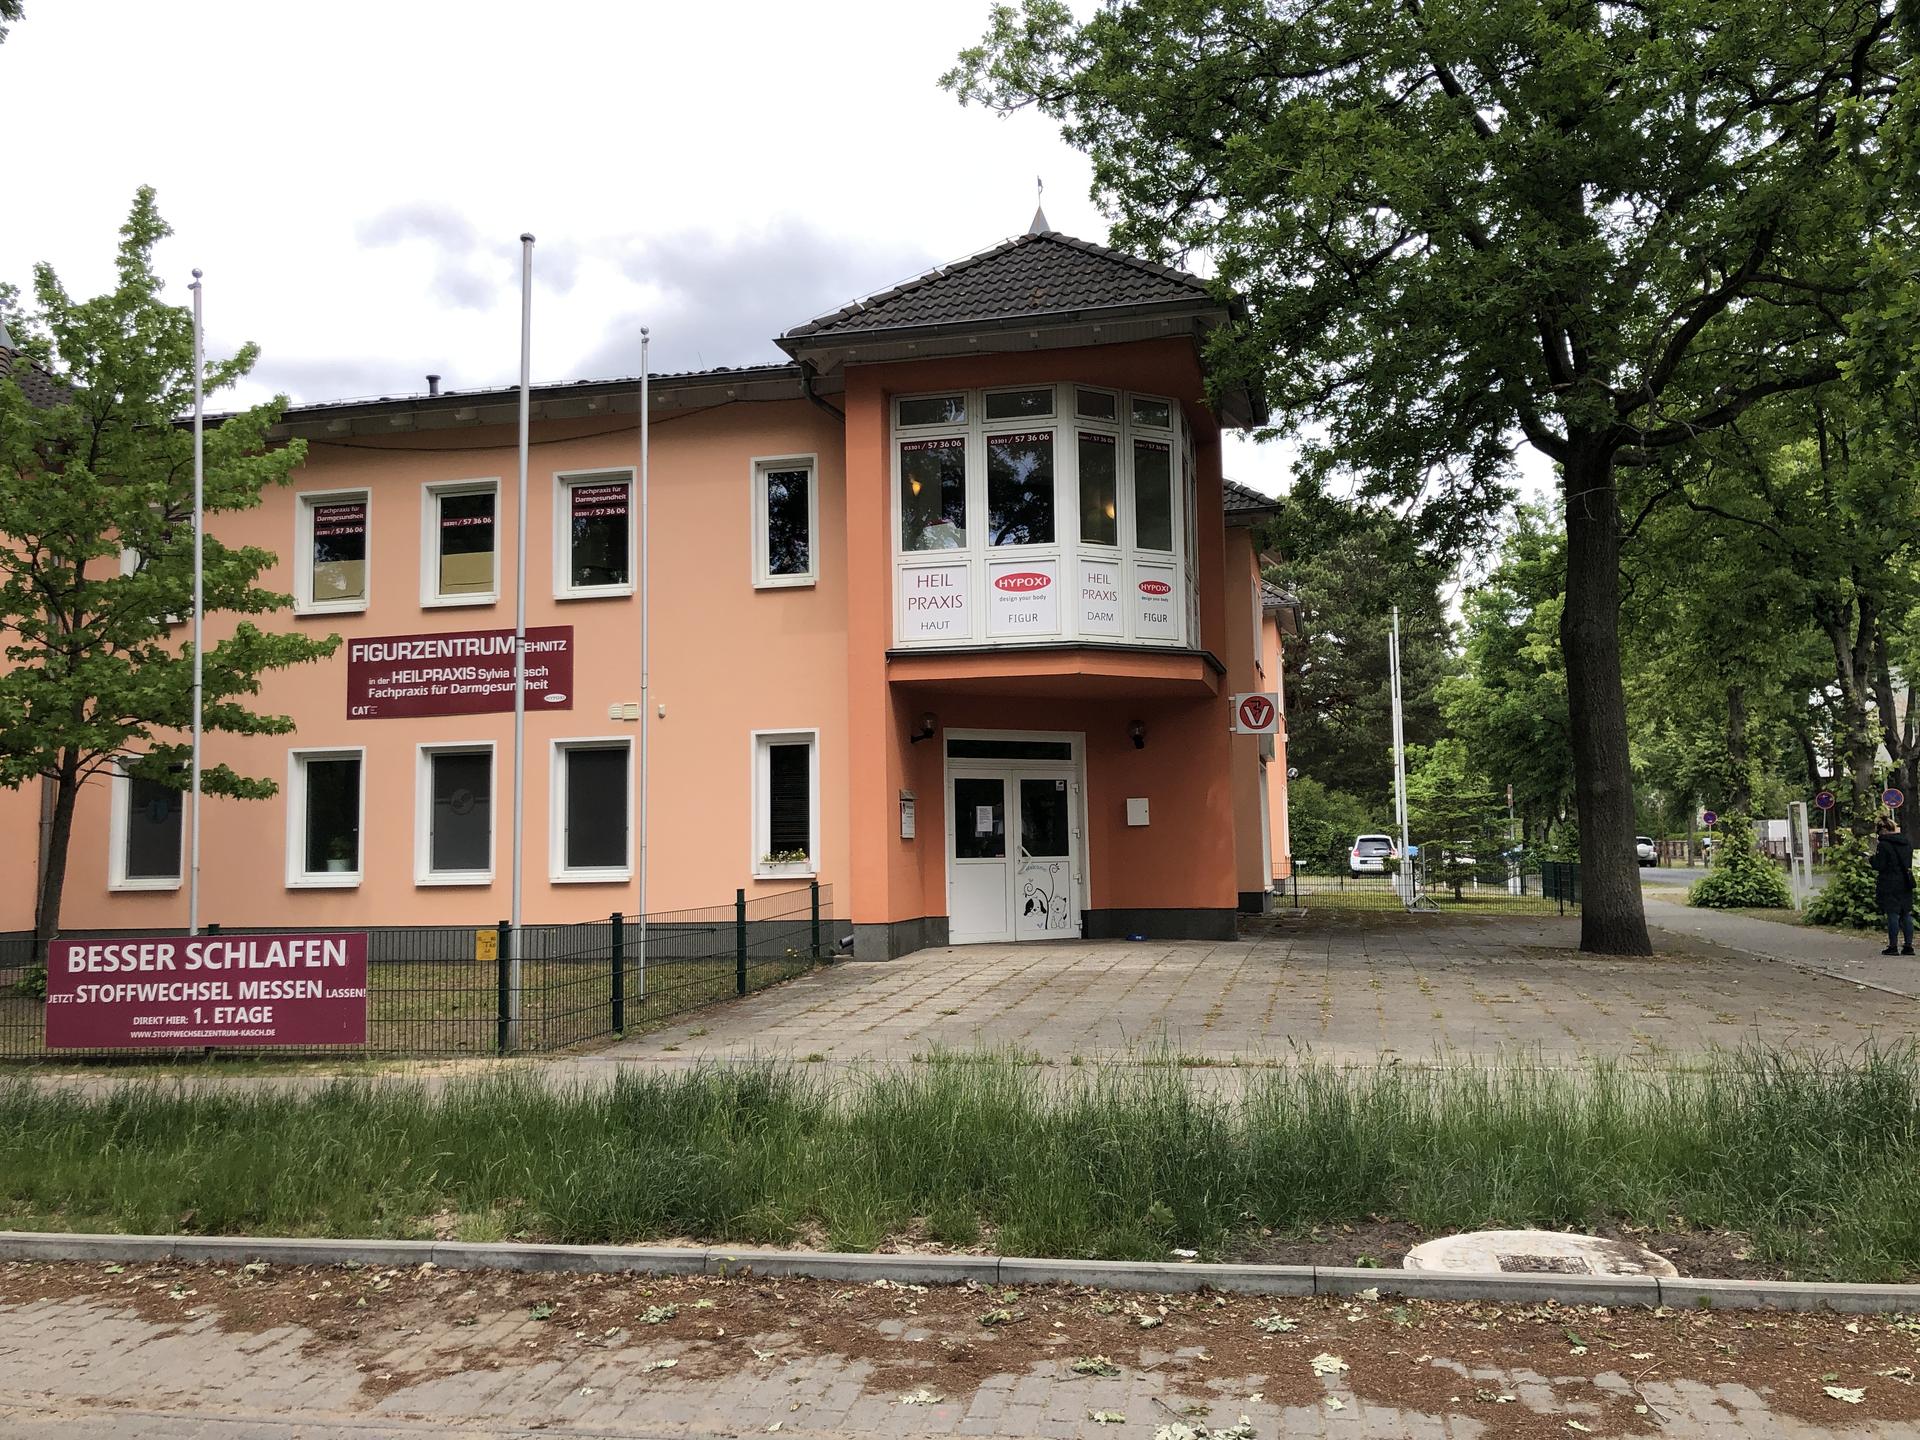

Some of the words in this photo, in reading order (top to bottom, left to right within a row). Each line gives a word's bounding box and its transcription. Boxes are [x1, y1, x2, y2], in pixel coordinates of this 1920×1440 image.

[575, 494, 626, 503] Darmgesundheit
[917, 574, 954, 588] HEIL
[999, 577, 1048, 588] HYPOXI
[1088, 572, 1112, 584] HEIL
[1140, 583, 1169, 592] HYPOXI
[1082, 588, 1118, 602] PRAXIS
[908, 594, 963, 610] PRAXIS
[1008, 613, 1038, 624] FIGUR
[1088, 612, 1114, 622] DARM
[1144, 612, 1168, 622] FIGUR
[921, 620, 950, 630] HAUT
[352, 636, 516, 662] FIGURZENTRUM
[524, 640, 567, 653] EHNITZ
[378, 676, 390, 684] der
[392, 666, 476, 684] HEILPRAXIS
[478, 668, 510, 682] Sylvia
[514, 666, 549, 678] asch
[368, 686, 428, 700] Fachpraxis
[431, 684, 448, 694] für
[450, 679, 549, 696] Darmgesunheit
[68, 944, 176, 973] BESSER
[185, 940, 347, 970] SCHLAFEN
[48, 994, 74, 1004] JETZT
[76, 981, 233, 1003] STOFFWECHSEL
[239, 980, 323, 1000] MESSEN
[326, 988, 366, 998] LASSEN!
[133, 1016, 164, 1025] DIREKT
[166, 1016, 188, 1024] HIER:
[194, 1007, 208, 1024] 1.
[214, 1006, 273, 1024] ETAGE
[130, 1028, 276, 1038] WWW.STOFFWECHSELZENTRUM-KASCH.DE
